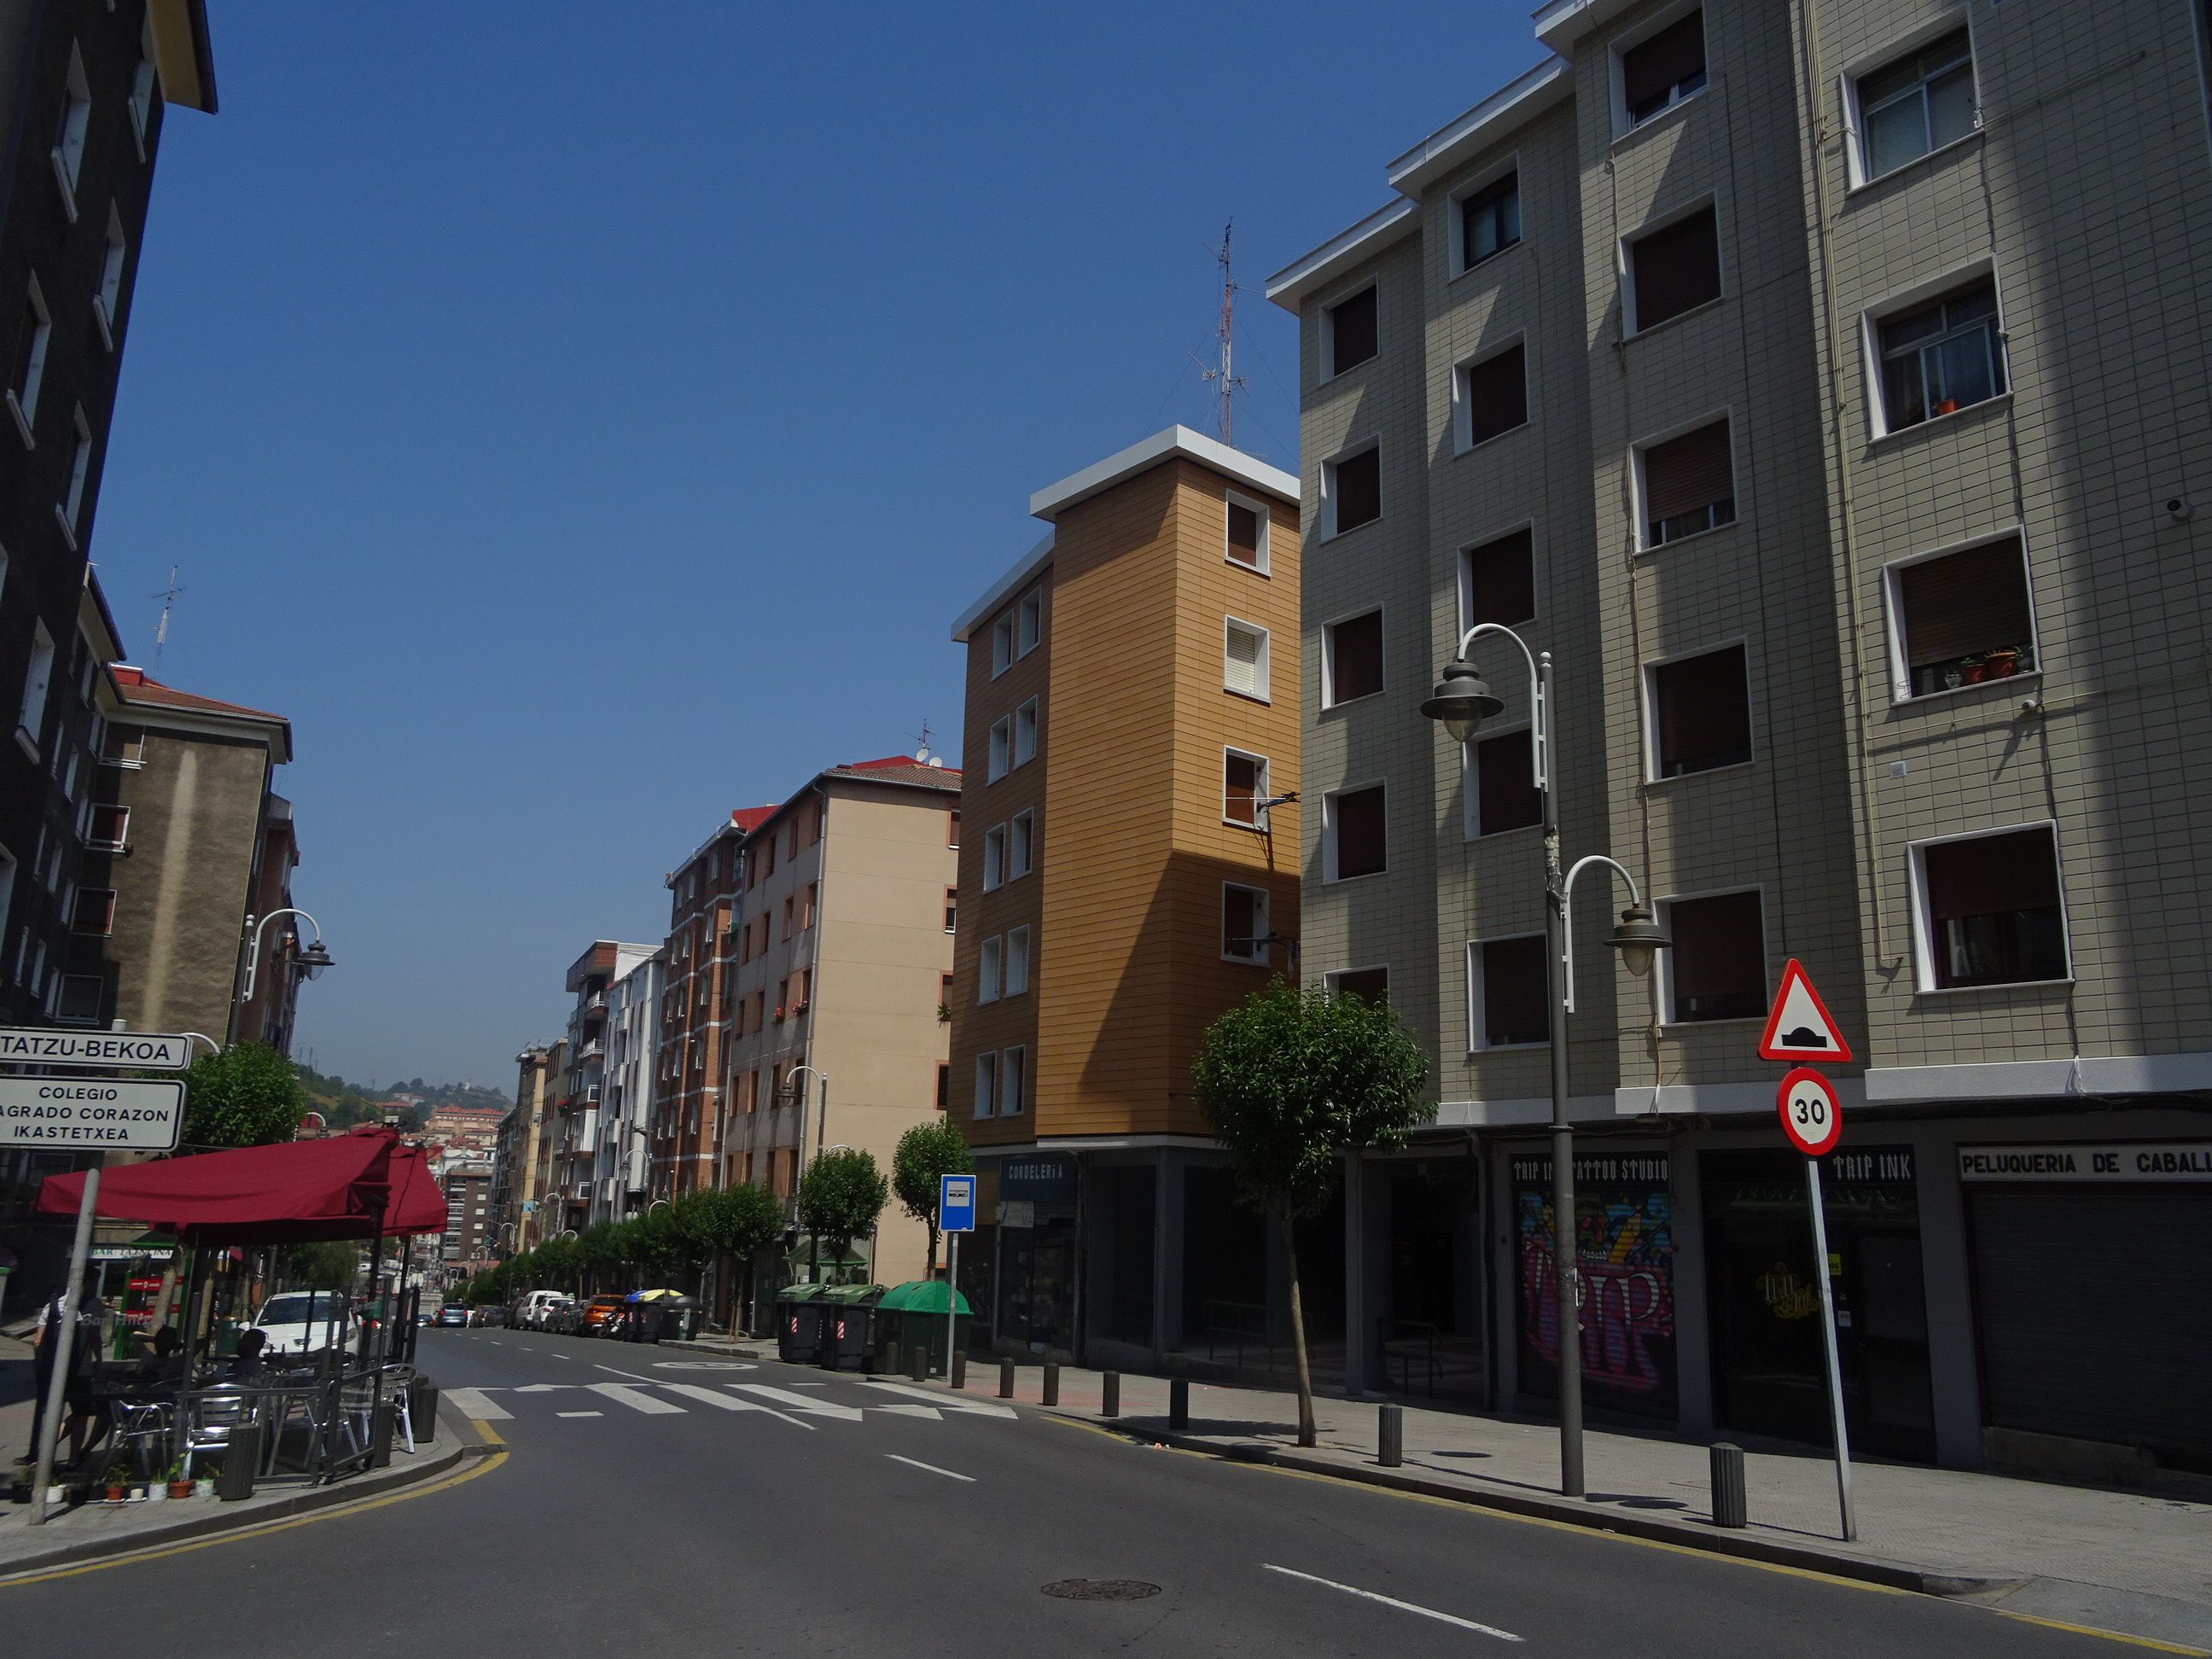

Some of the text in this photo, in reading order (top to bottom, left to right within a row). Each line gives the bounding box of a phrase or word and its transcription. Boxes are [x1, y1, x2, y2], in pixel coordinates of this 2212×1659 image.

[38, 1086, 118, 1101] COLEGIO
[79, 1108, 169, 1122] CORAZON
[1795, 1098, 1825, 1125] 30
[14, 1125, 129, 1140] IKASTETXEA
[1514, 1160, 1539, 1182] TRIP
[1572, 1159, 1617, 1181] ATTOO
[1621, 1158, 1668, 1181] STUDIO
[1832, 1153, 1912, 1181] TRIP INK
[1962, 1153, 2076, 1173] PELUQUERIA
[2092, 1153, 2120, 1173] DE
